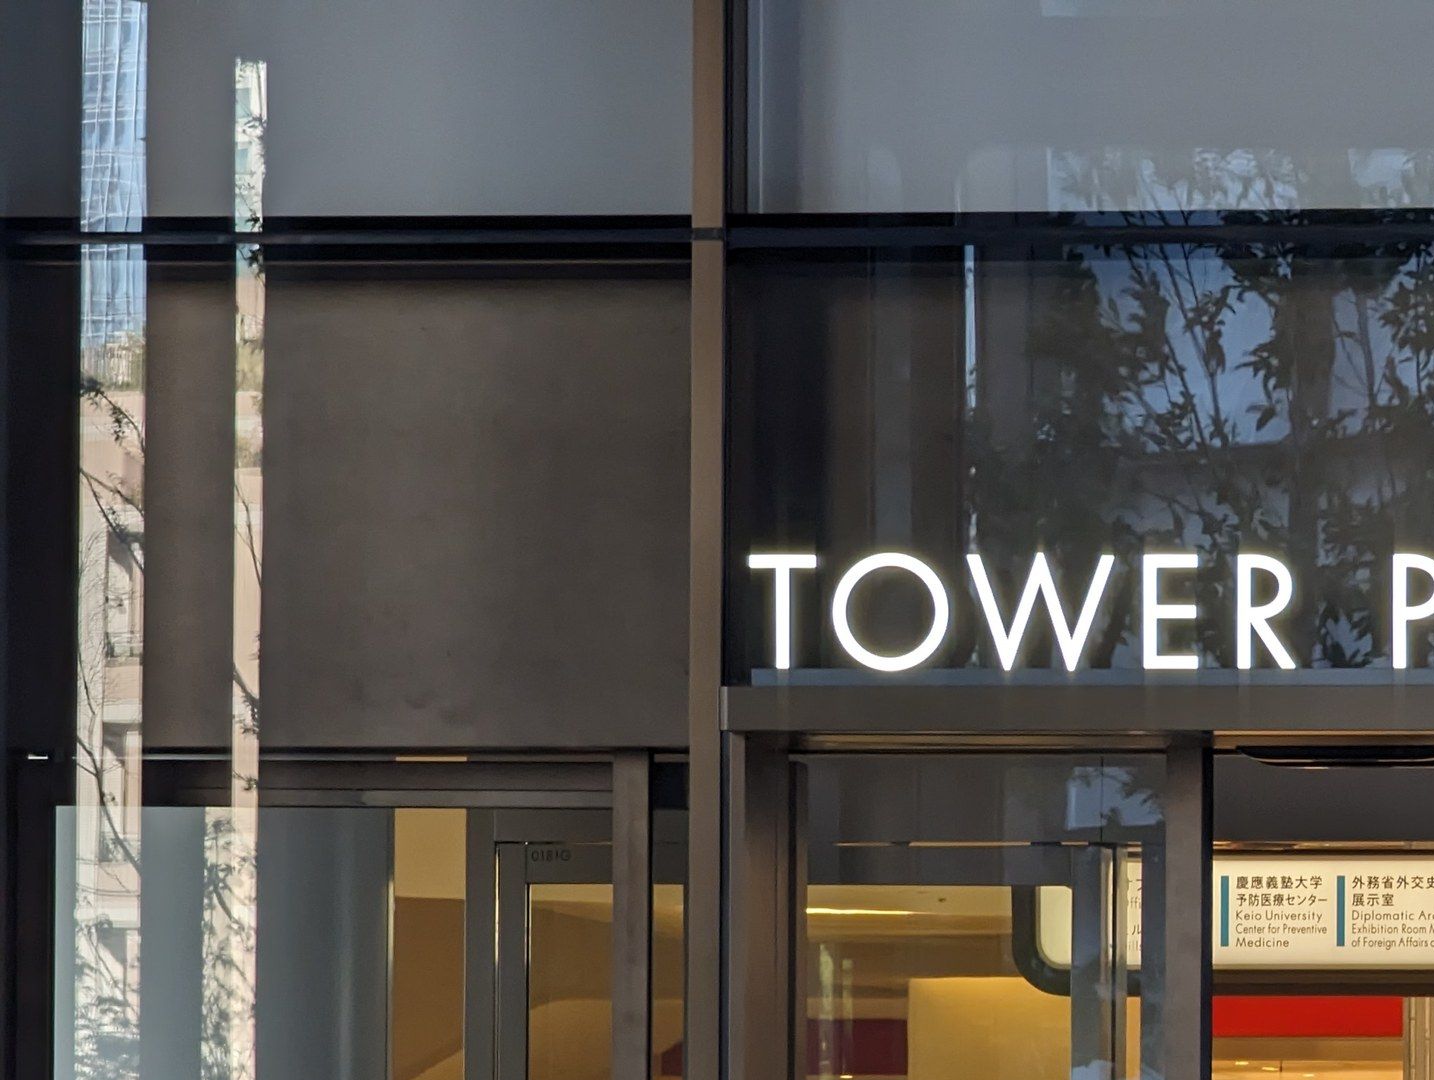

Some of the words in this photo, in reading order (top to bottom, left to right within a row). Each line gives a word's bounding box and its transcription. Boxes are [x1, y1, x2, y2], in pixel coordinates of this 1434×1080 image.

[748, 552, 1296, 671] TOWER
[1236, 876, 1322, 889] 慶應義塾大学
[1236, 893, 1327, 907] 予防医療センター
[1352, 893, 1394, 907] 展示室
[1236, 910, 1262, 921] Keio
[1265, 910, 1322, 923] University
[1352, 910, 1414, 923] Diplomatic
[1236, 923, 1265, 934] Center
[1268, 923, 1280, 934] for
[1283, 923, 1327, 934] Preventive
[1352, 924, 1398, 934] Exhibition
[1401, 923, 1426, 934] Room
[1236, 937, 1289, 947] Medicine
[1351, 937, 1361, 947] of
[1363, 937, 1396, 950] Foreign
[1398, 937, 1428, 948] Affairs
